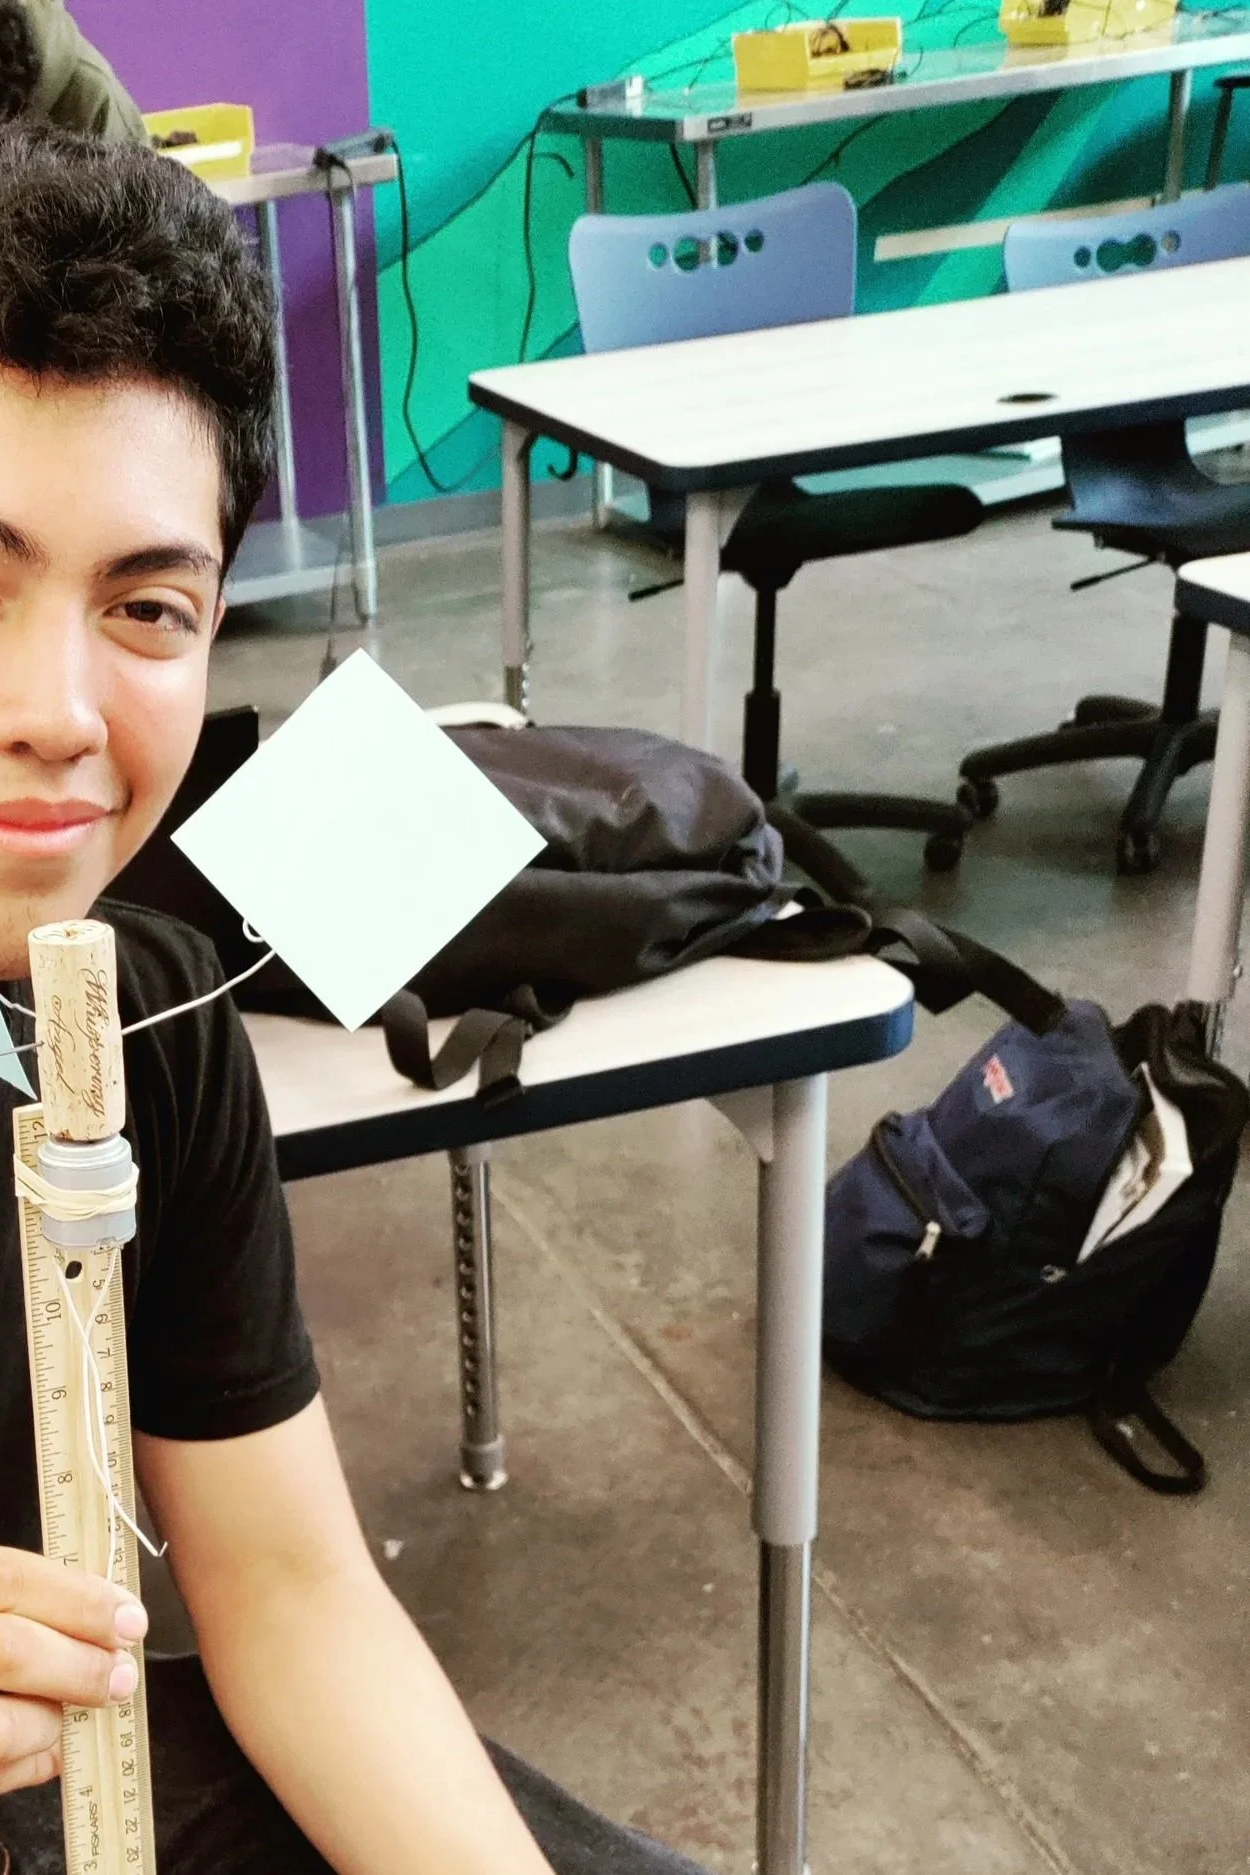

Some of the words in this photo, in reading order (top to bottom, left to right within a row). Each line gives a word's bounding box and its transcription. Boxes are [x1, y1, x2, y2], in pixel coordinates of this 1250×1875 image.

[46, 994, 76, 1095] Angel
[75, 968, 110, 1117] Whispering
[32, 1120, 48, 1140] 12
[45, 1301, 62, 1321] 10
[57, 1472, 73, 1484] 8
[73, 1713, 88, 1722] 5
[120, 1731, 134, 1748] 19
[121, 1758, 135, 1777] 20
[123, 1787, 136, 1804] 21
[125, 1817, 138, 1835] 22
[126, 1845, 140, 1863] 23
